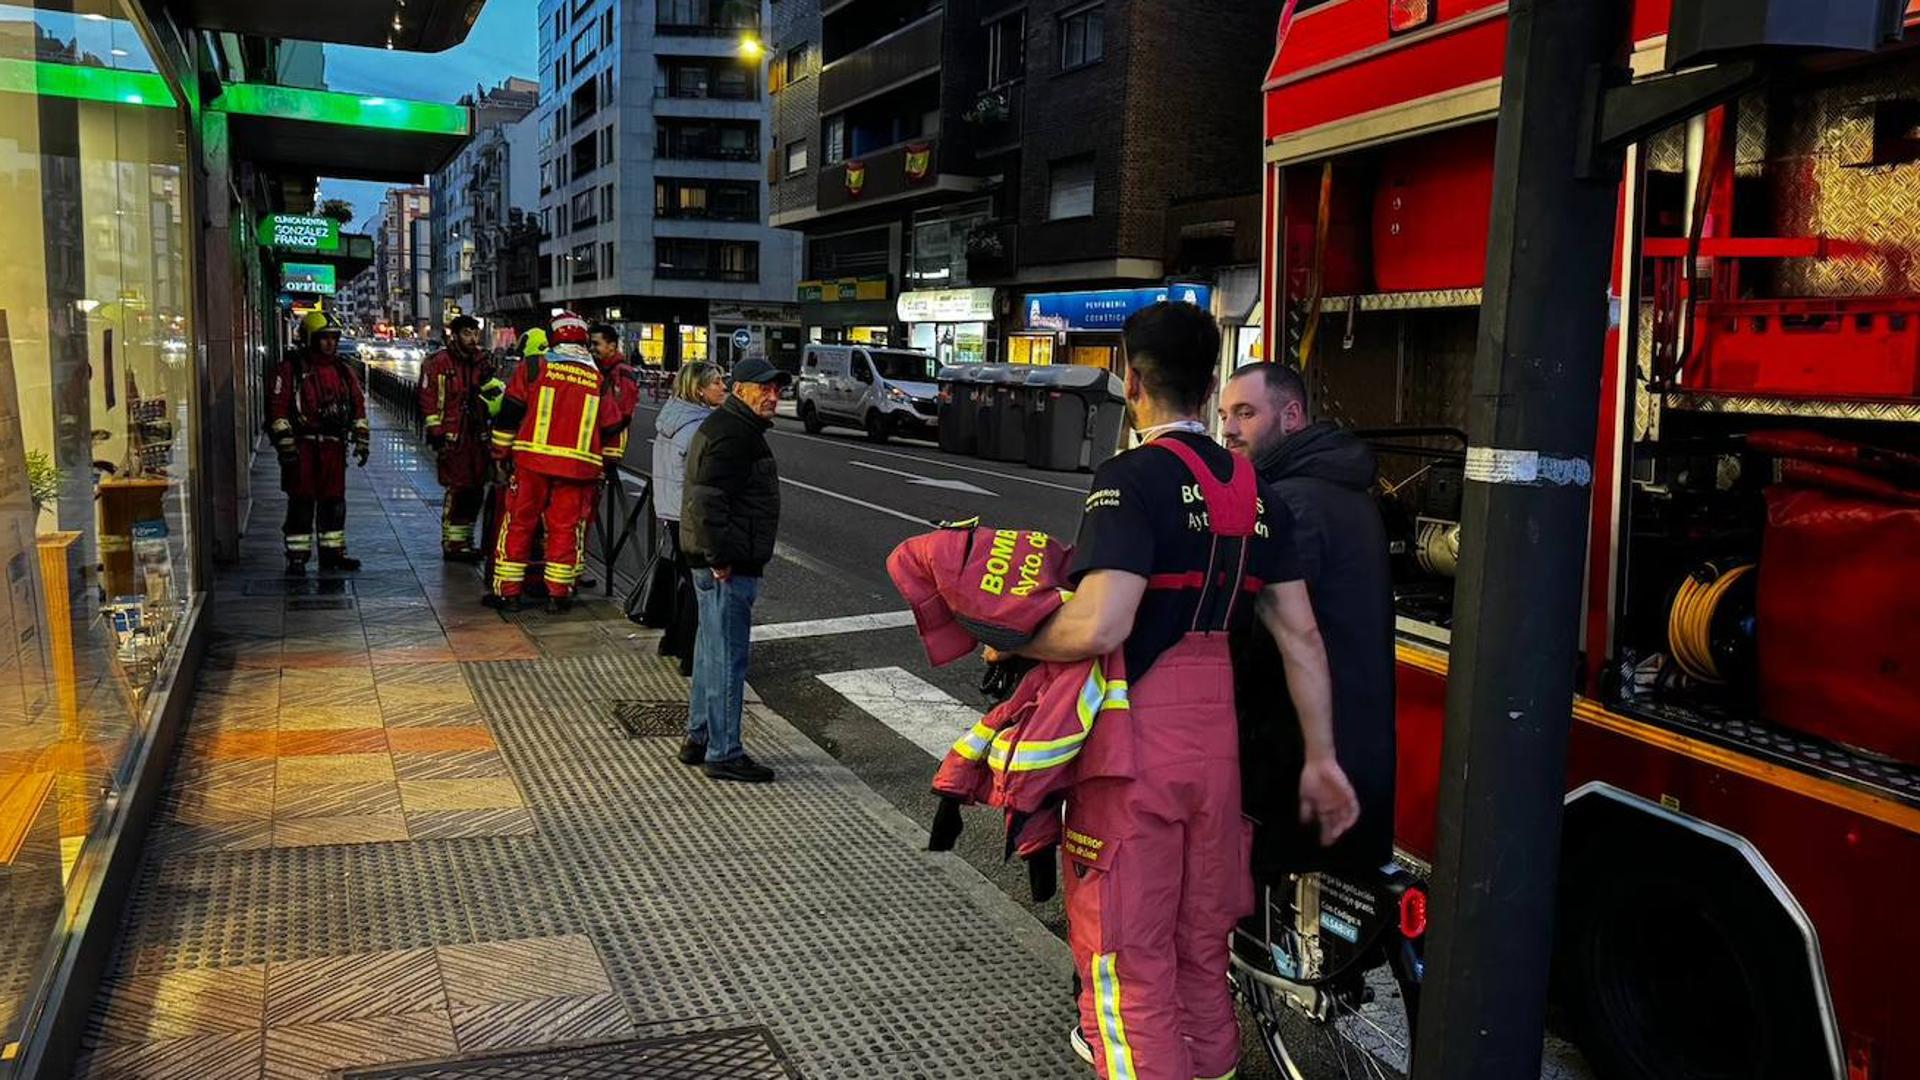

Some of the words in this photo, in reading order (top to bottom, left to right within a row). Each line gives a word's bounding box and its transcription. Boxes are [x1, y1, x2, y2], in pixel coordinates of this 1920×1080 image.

[274, 215, 300, 225] CLÍNICA
[301, 217, 329, 227] DENTAL
[274, 225, 329, 238] GONZÁLEZ
[274, 234, 317, 246] FRANCO
[547, 363, 598, 380] BOMBEROS
[1188, 511, 1210, 531] Ayt
[980, 529, 1018, 596] BOMB
[1010, 552, 1044, 596] Ayto.
